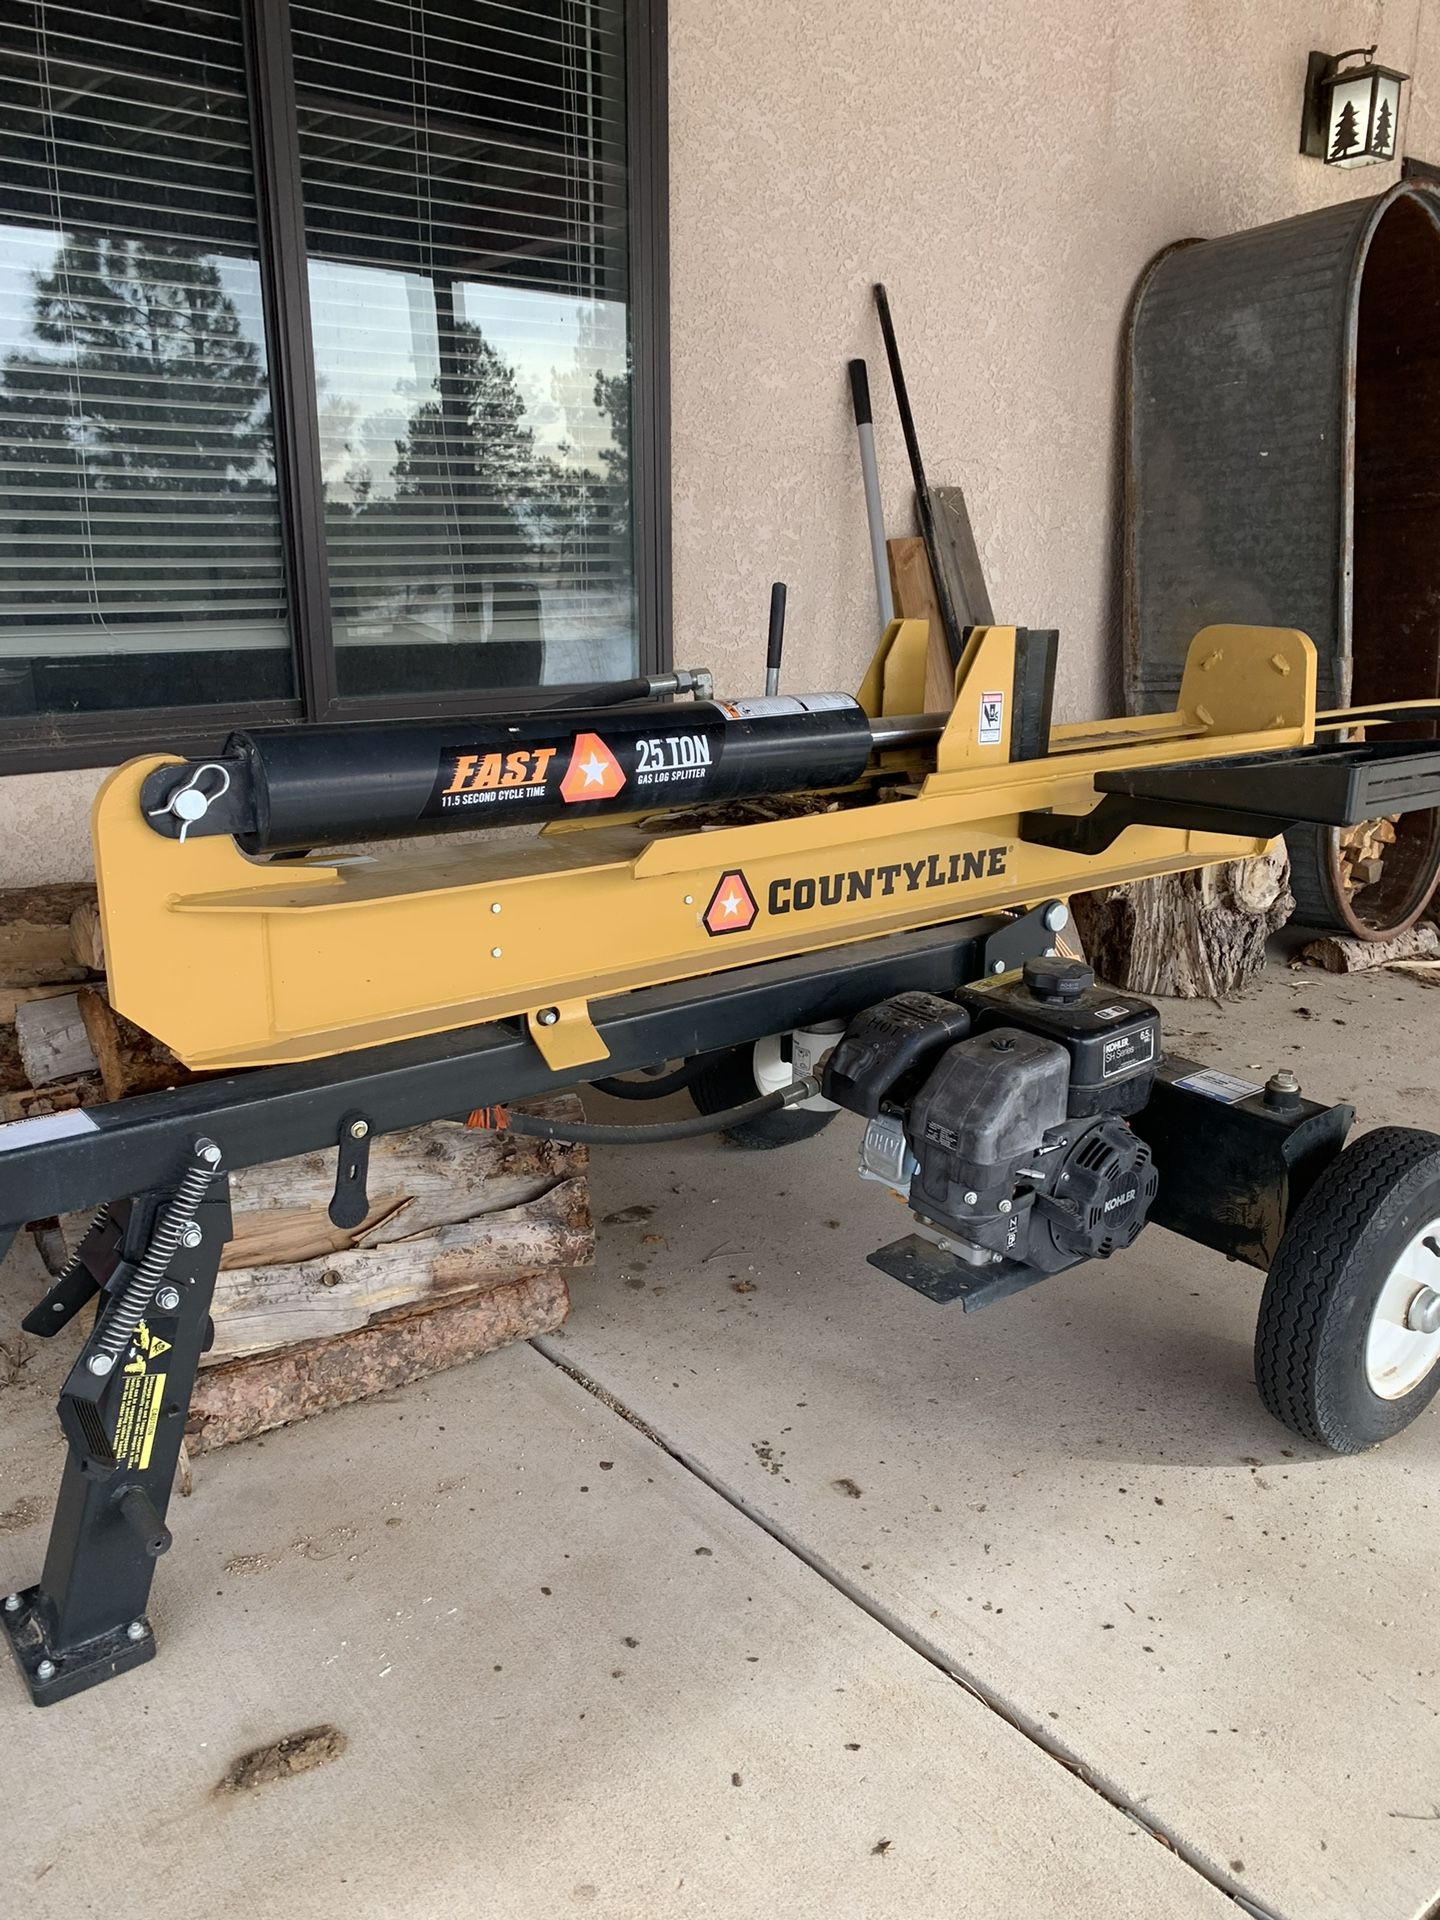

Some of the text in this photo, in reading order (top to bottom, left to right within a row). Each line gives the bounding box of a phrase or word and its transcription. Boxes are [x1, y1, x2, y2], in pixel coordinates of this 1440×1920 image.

[635, 734, 711, 771] 25 TON
[442, 747, 557, 793] FAST
[637, 767, 706, 785] GAS LOG SPLITTER
[442, 786, 546, 807] 11.5 SECOND CYCLE TIME
[867, 1017, 901, 1036] HOT
[1105, 1037, 1130, 1054] KOHLER
[1105, 1052, 1116, 1063] SH
[1116, 1046, 1135, 1059] Series
[1104, 1189, 1136, 1213] KOHLER
[147, 1407, 158, 1435] CAUTION
